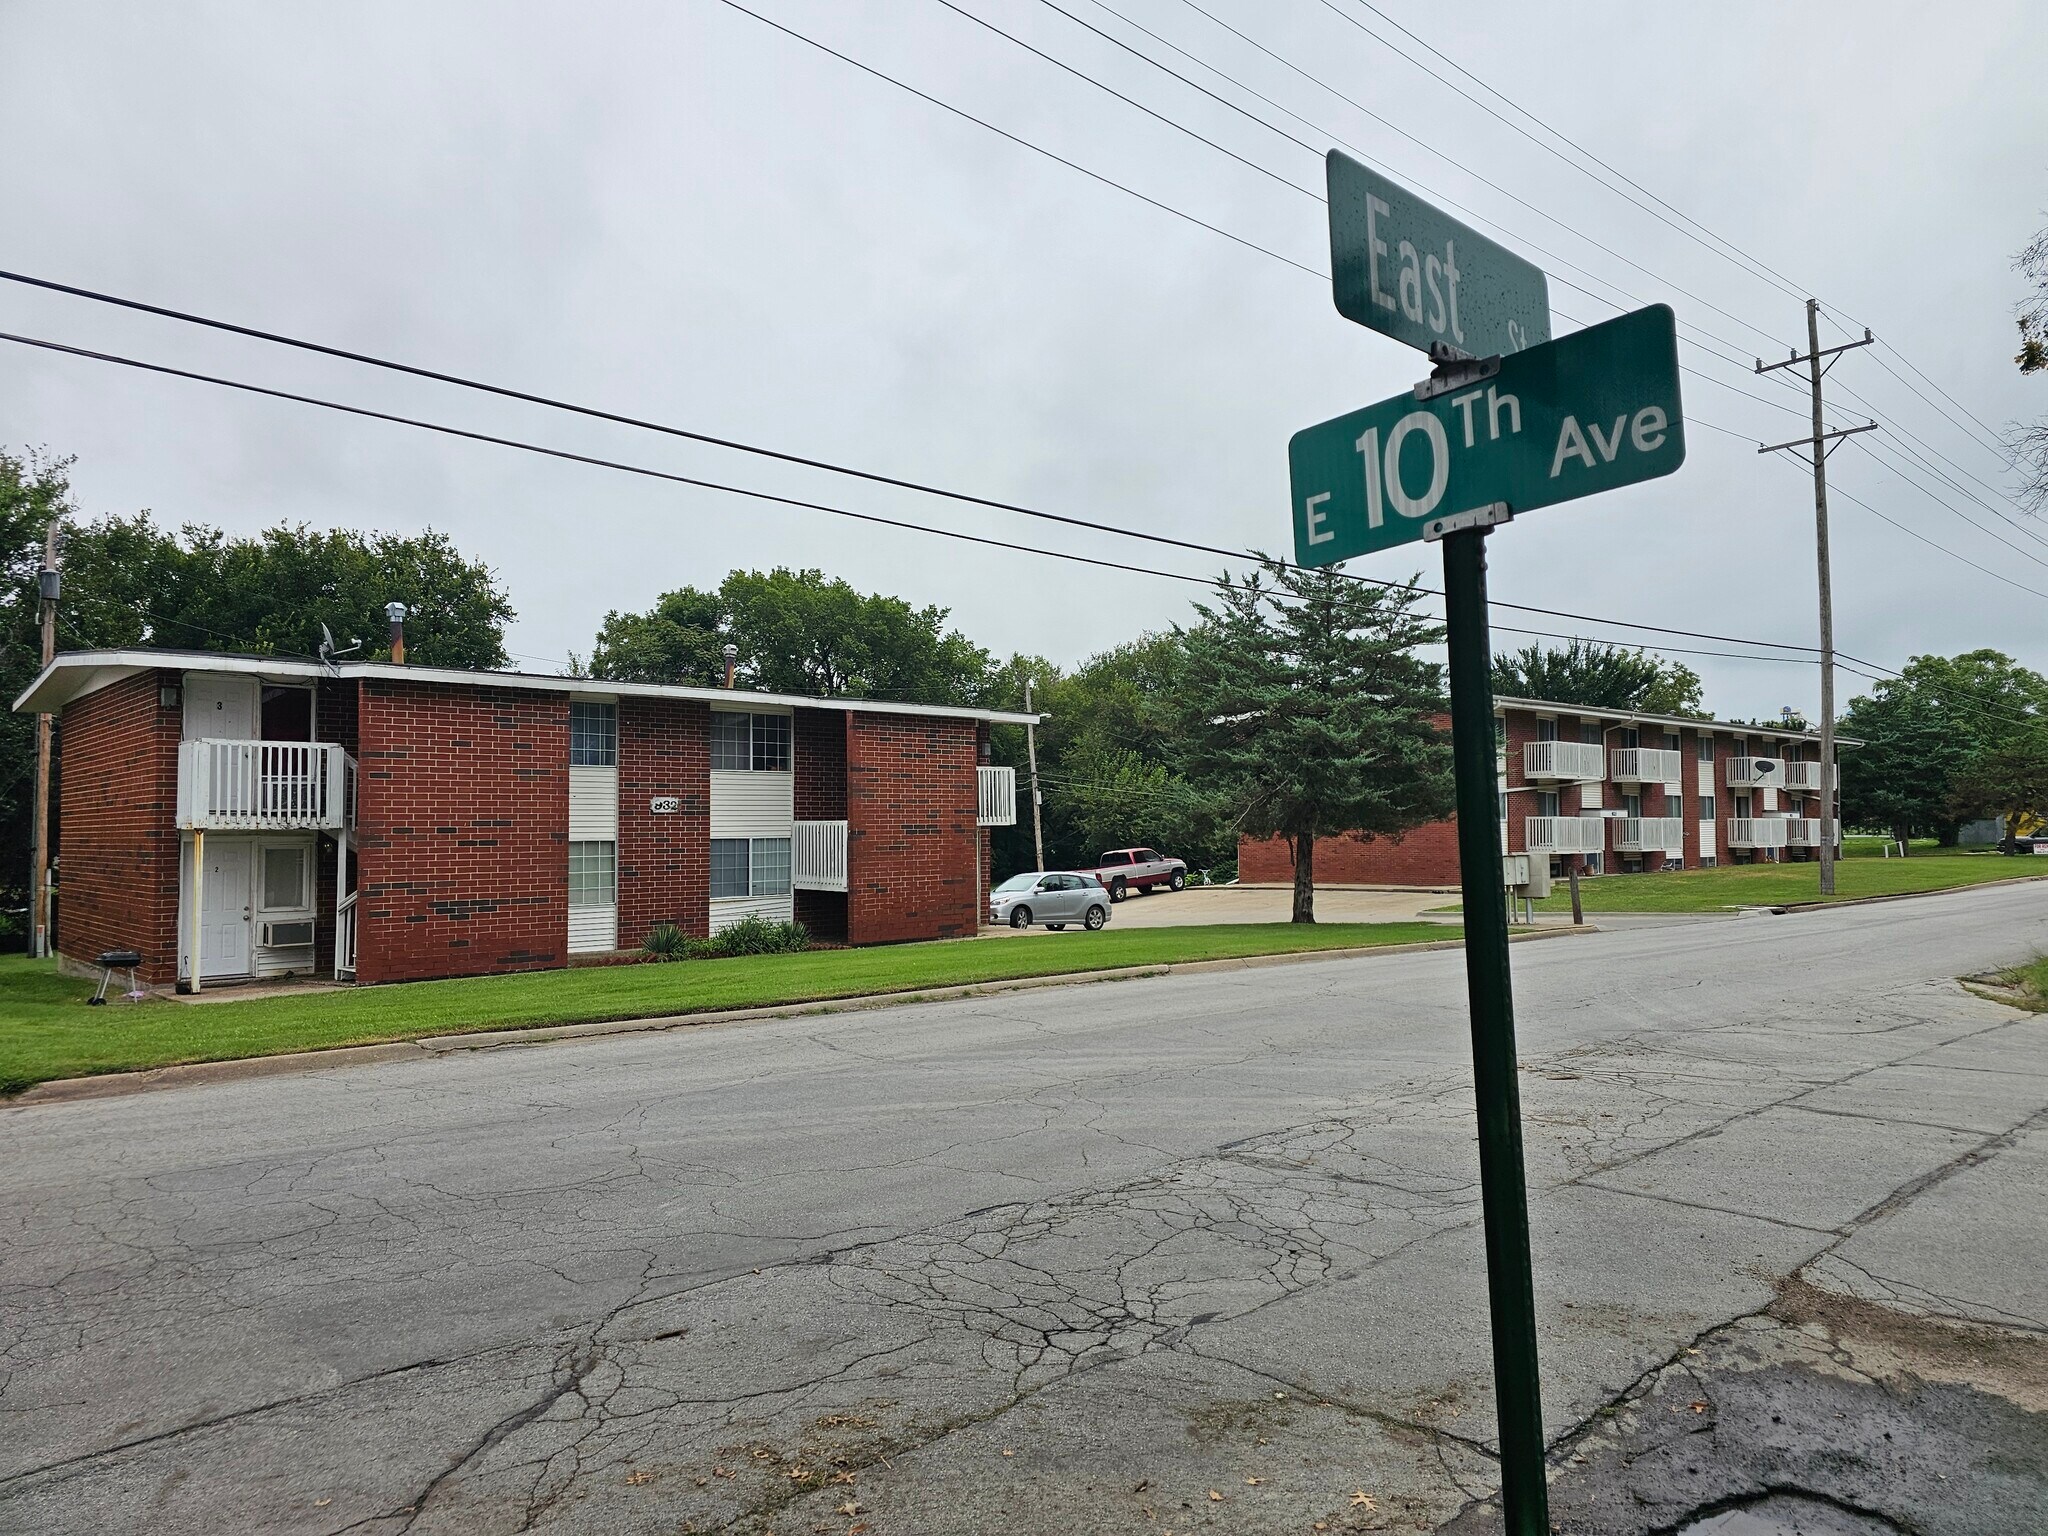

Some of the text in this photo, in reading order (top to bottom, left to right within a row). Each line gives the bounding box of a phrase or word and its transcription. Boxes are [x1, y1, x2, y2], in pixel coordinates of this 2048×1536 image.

[1366, 191, 1528, 352] East St
[1306, 490, 1335, 546] E
[1549, 405, 1669, 479] Ave
[216, 701, 223, 711] 3
